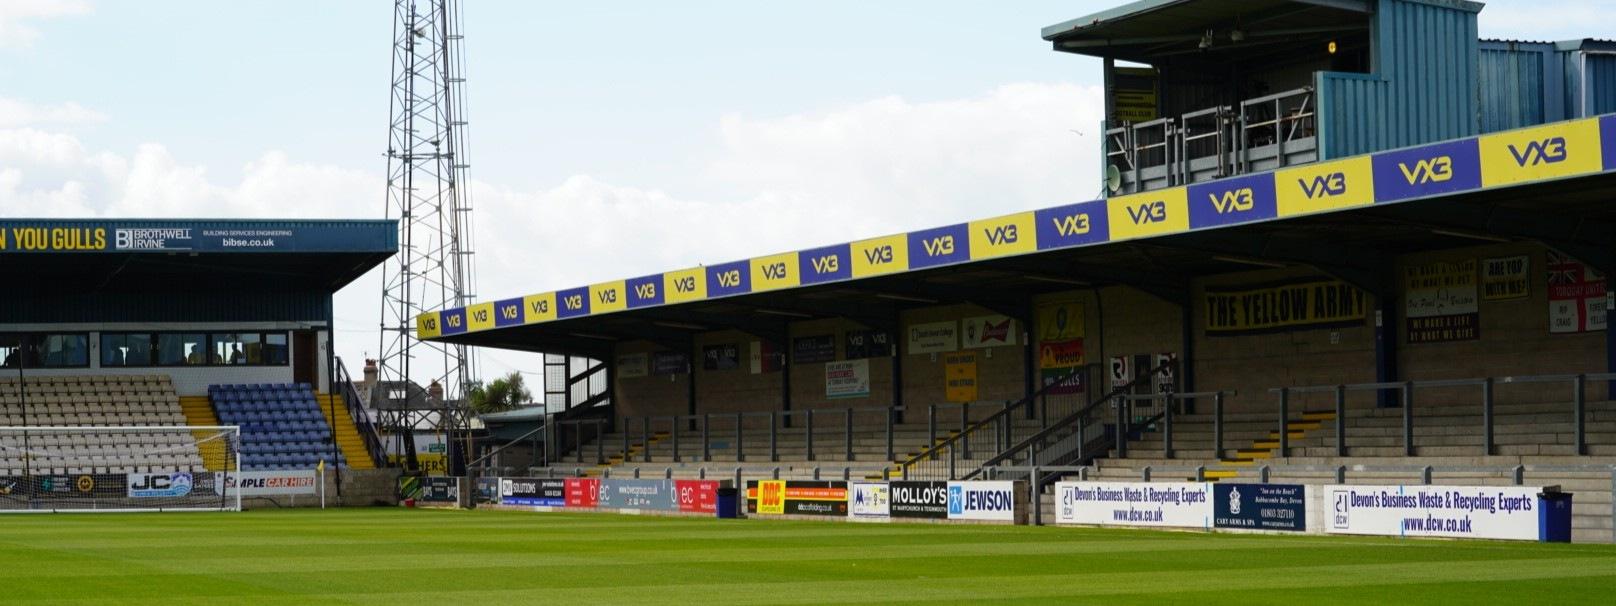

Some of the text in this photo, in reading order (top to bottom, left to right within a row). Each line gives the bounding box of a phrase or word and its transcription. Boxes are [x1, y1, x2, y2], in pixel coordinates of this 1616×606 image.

[1508, 137, 1567, 166] VX3
[1398, 156, 1452, 184] VX3
[1298, 172, 1346, 198] VX3
[1209, 188, 1254, 214] VX3
[1126, 202, 1166, 224] VX3
[1054, 214, 1090, 237] VX3
[13, 228, 48, 250] YOU
[52, 228, 106, 250] GULLS
[134, 230, 192, 239] BROTHWELL
[985, 224, 1017, 246] VX3
[134, 240, 165, 248] IRVINE
[923, 235, 954, 256] VX3
[812, 254, 838, 273] VX3
[864, 246, 893, 264] VX3
[762, 263, 786, 280] VX3
[1489, 260, 1522, 275] ARE YOU
[674, 276, 696, 292] VX3
[717, 271, 740, 288] VX3
[598, 290, 616, 304] VX3
[635, 284, 656, 298] VX3
[532, 300, 548, 314] VX3
[564, 296, 582, 310] VX3
[1209, 284, 1366, 326] THE YELLOW ARMY
[473, 310, 488, 323] VX3
[502, 306, 518, 319] VX3
[422, 318, 436, 330] VX3
[447, 315, 460, 328] VX3
[266, 478, 288, 488] CAR
[289, 477, 314, 487] HIRE
[513, 482, 536, 493] SOLUTIONS
[893, 487, 946, 504] MOLLOY'S
[965, 490, 1011, 511] JEWSON
[1074, 486, 1206, 506] Devon's Business Waste & Recycling Experts
[1350, 491, 1532, 514] Devon's Business Waste & Recycling Experts
[1113, 506, 1163, 522] www.dcw.co.uk
[1261, 508, 1276, 518] 01803
[1336, 514, 1347, 524] dcw
[1404, 514, 1472, 532] www.dcw.co.uk
